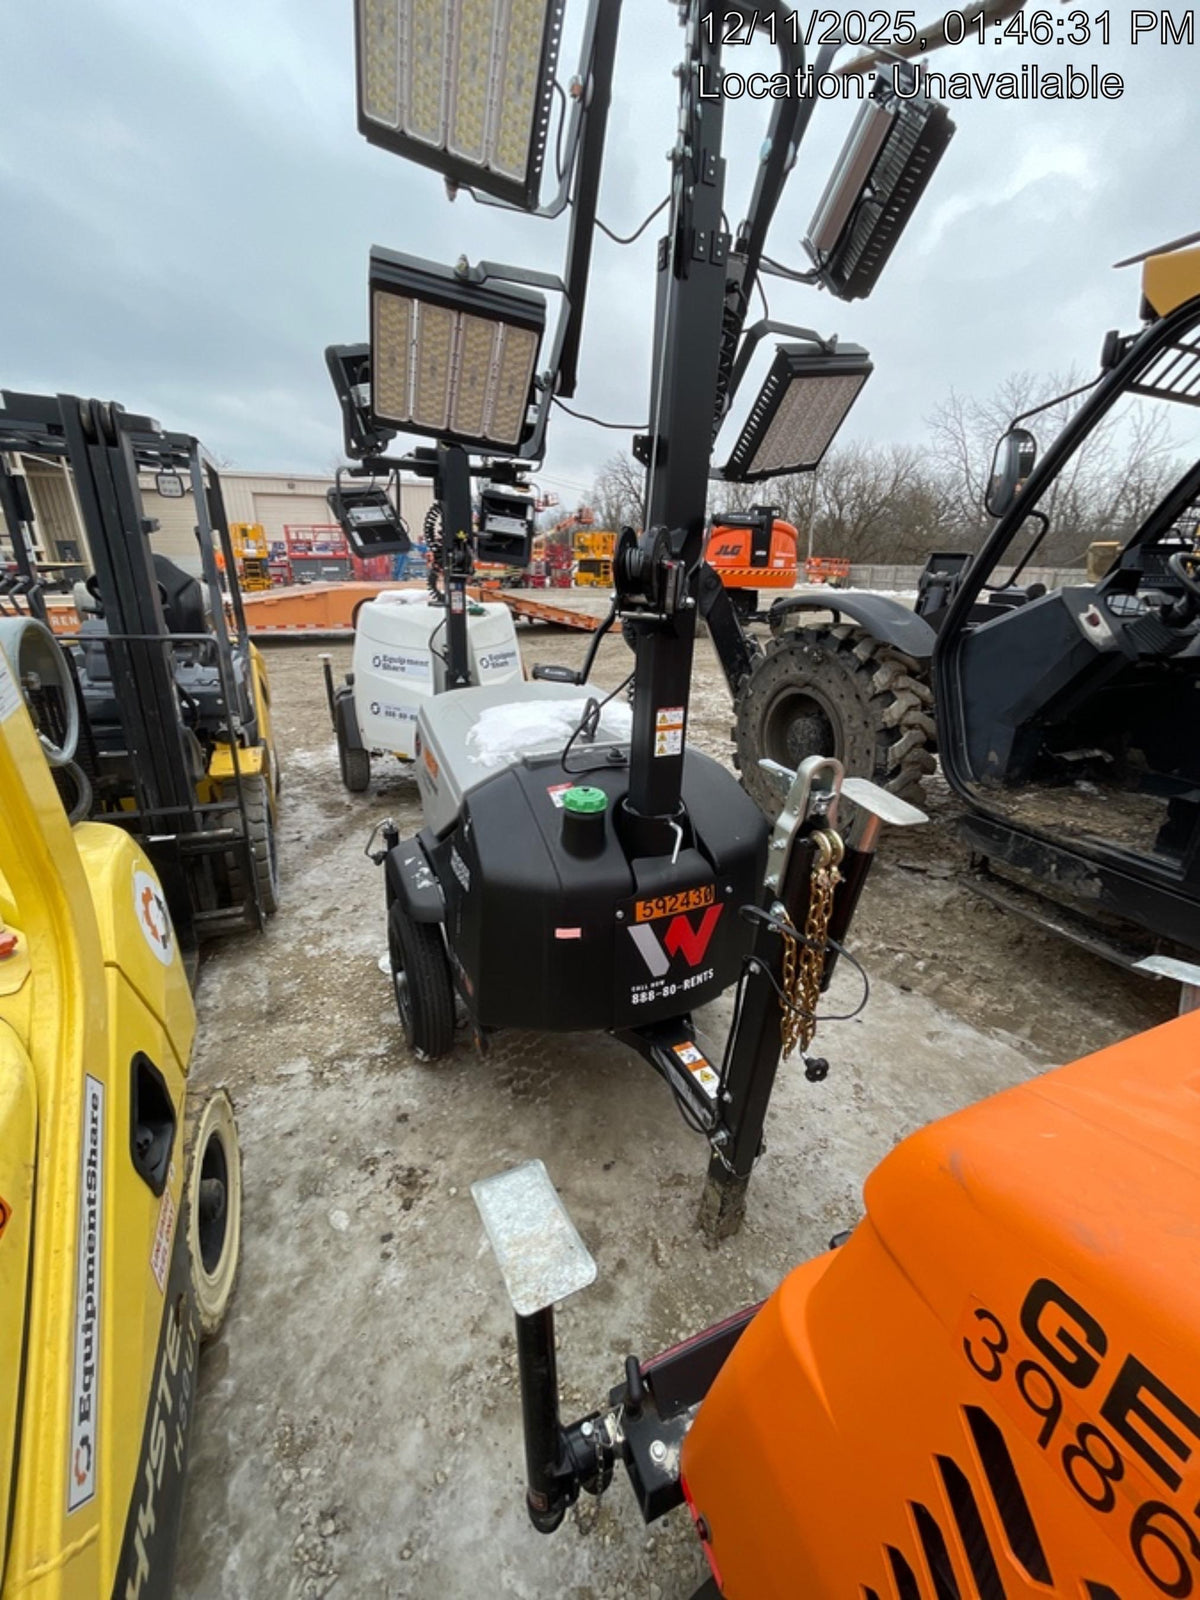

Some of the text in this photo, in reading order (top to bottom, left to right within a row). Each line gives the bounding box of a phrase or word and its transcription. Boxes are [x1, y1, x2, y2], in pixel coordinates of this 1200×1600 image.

[715, 544, 743, 557] JLG
[382, 663, 407, 673] Share
[631, 968, 714, 1004] 888-80-RENTS
[79, 1093, 101, 1425] EquipmentShare
[1019, 1277, 1200, 1519] GE
